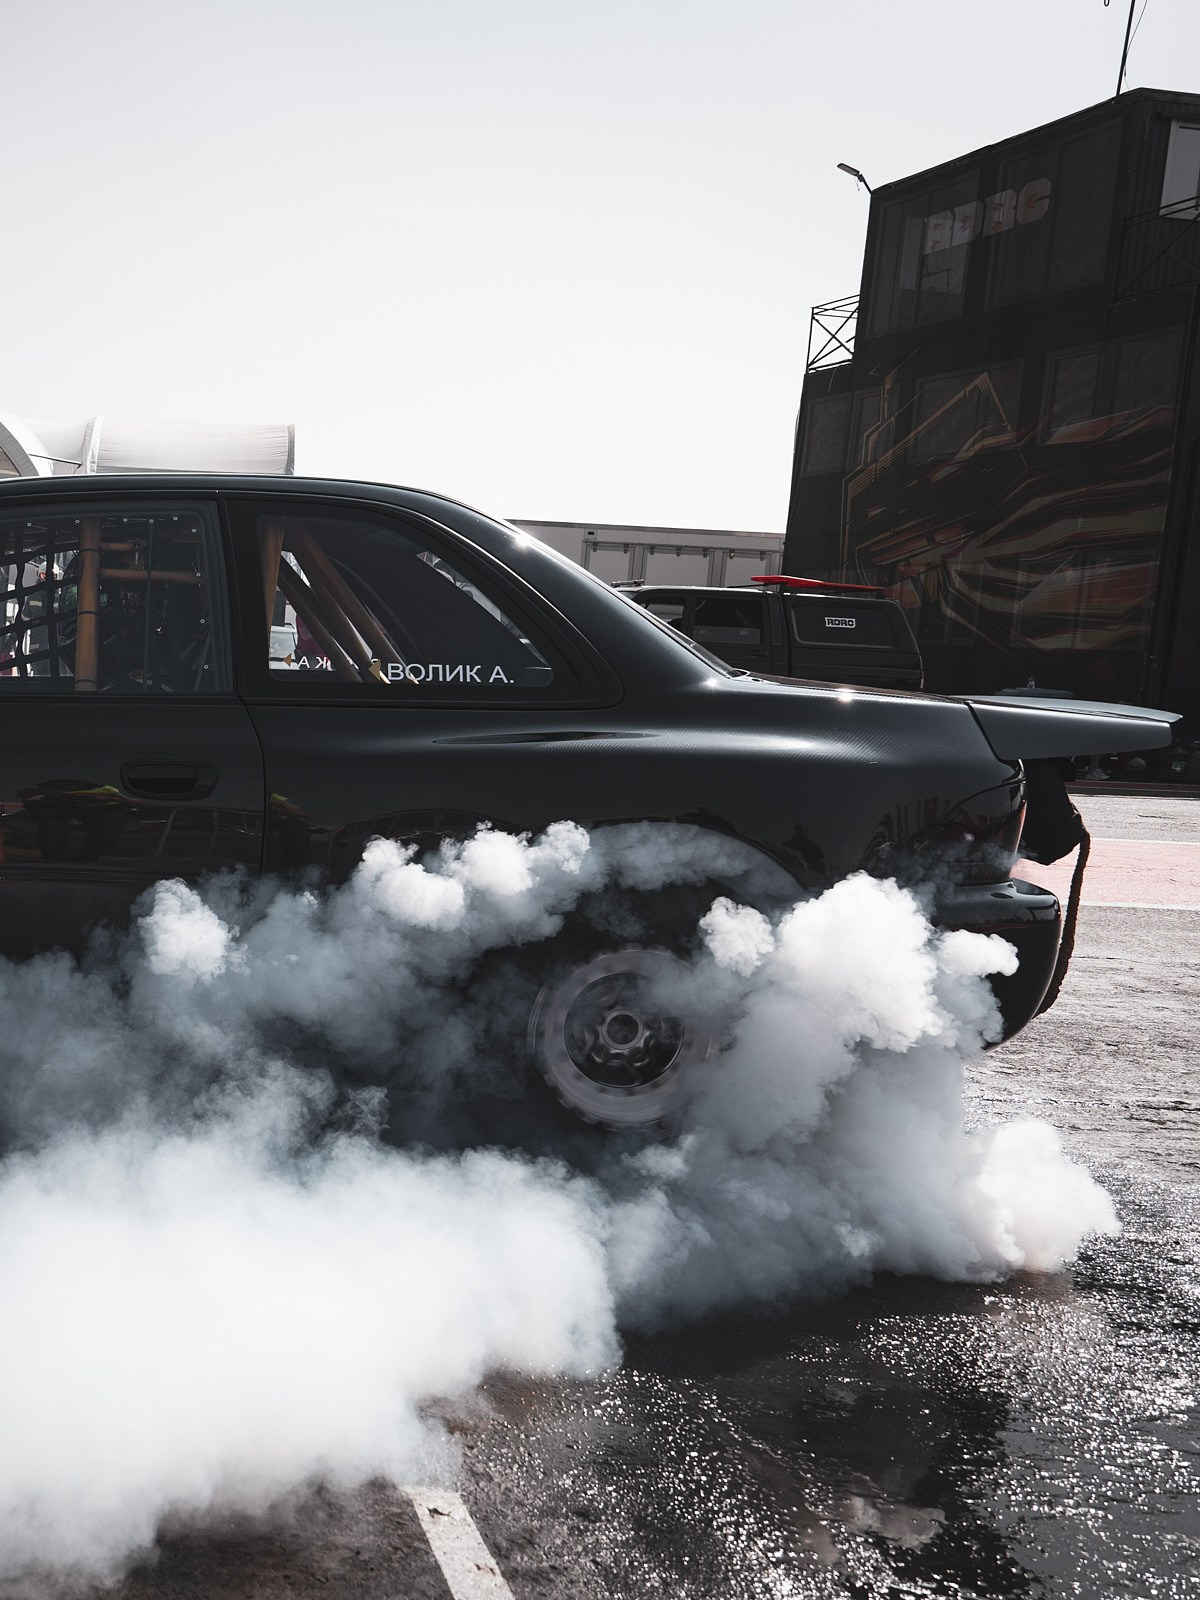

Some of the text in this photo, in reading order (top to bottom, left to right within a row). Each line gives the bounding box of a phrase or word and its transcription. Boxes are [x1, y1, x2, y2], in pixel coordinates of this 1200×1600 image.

[827, 618, 854, 627] RDRC
[388, 662, 515, 684] ВОЛИК А.
